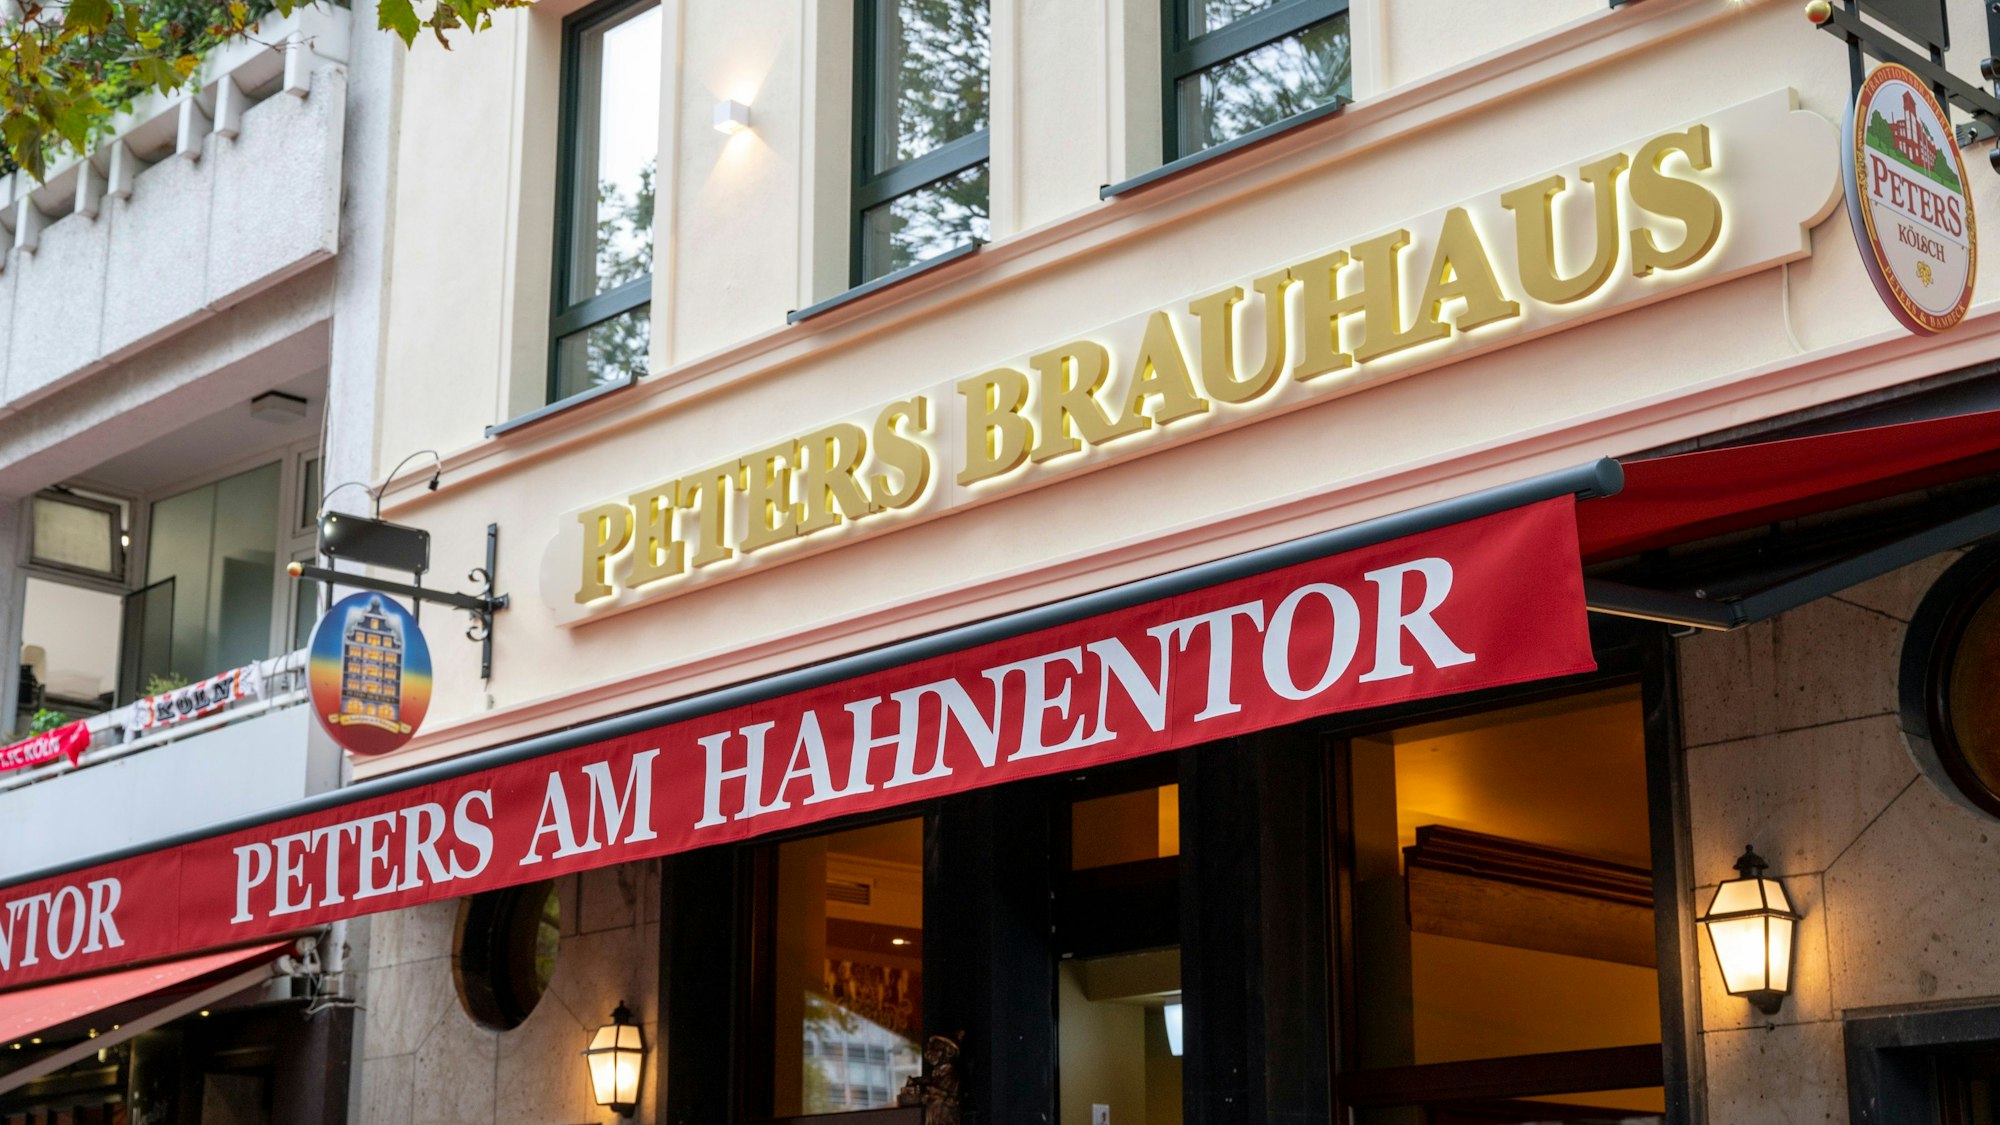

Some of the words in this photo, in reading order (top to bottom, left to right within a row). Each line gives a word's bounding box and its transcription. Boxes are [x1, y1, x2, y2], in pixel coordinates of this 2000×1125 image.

[1870, 154, 1962, 237] PETERS
[1898, 223, 1945, 263] KÖLSCH
[1885, 266, 1917, 314] PETERS
[1920, 313, 1927, 324] &
[1930, 302, 1965, 328] BAMBECK
[574, 395, 931, 605] PETERS
[957, 123, 1723, 486] BRAUHAUS
[156, 677, 233, 721] KÖLN
[231, 789, 494, 925] PETERS
[519, 748, 661, 866] AM
[694, 557, 1476, 830] HAHNENTOR
